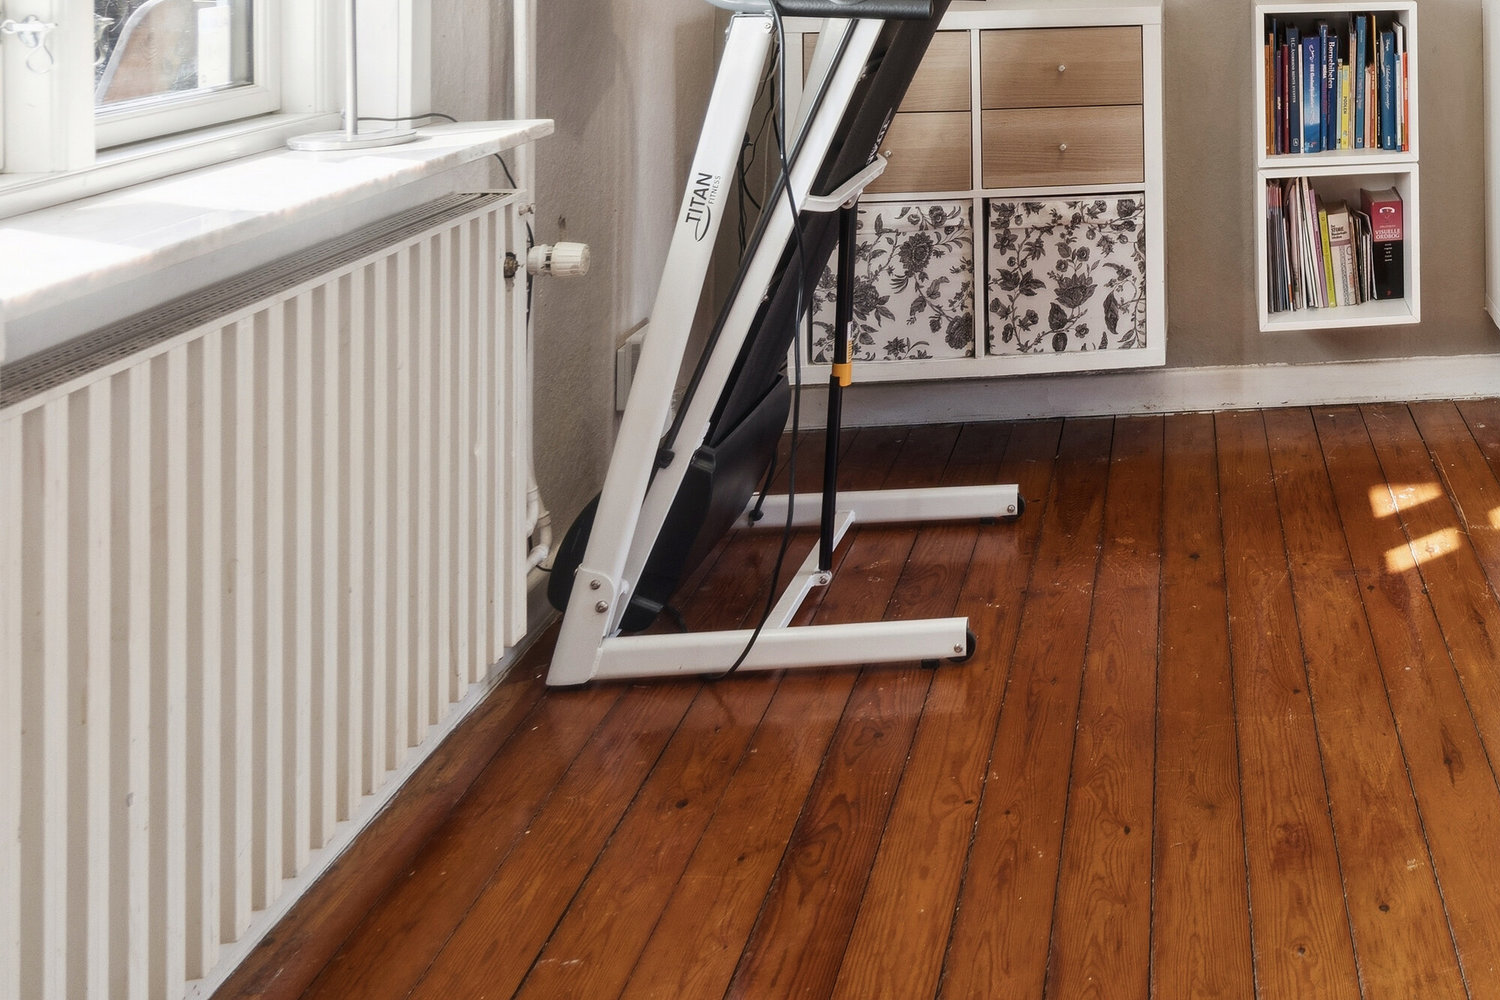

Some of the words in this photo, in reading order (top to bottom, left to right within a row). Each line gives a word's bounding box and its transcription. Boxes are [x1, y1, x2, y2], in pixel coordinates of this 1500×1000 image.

[1327, 41, 1336, 88] Børnebibelen
[685, 172, 713, 222] TITAN
[708, 175, 721, 205] FITNESS
